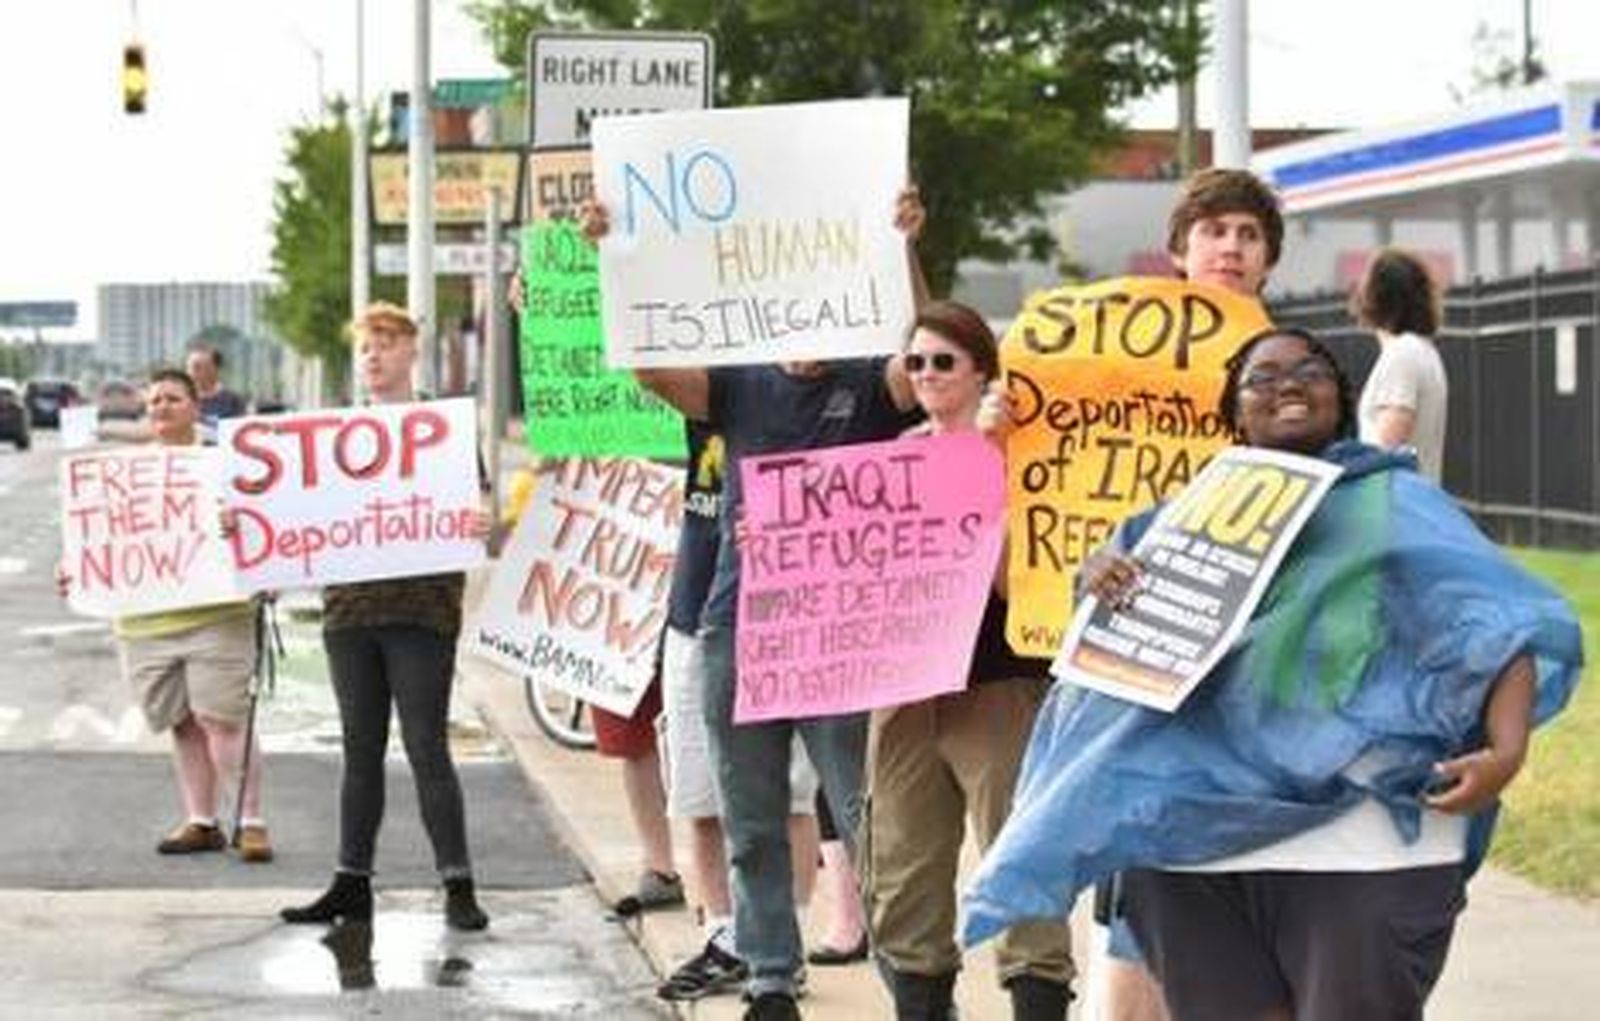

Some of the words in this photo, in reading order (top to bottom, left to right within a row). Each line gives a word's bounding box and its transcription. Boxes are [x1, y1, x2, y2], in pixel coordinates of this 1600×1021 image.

[542, 55, 619, 85] RIGHT
[631, 59, 700, 88] LANE
[622, 150, 737, 237] NO
[713, 217, 860, 287] HUMAN
[628, 299, 706, 352] IS
[1023, 293, 1224, 369] STOP
[68, 453, 200, 498] FREE
[231, 410, 449, 495] STOP
[1022, 434, 1076, 495] of
[1087, 437, 1214, 502] IRA
[69, 494, 200, 539] THEM
[757, 454, 926, 531] IRAQI
[1162, 463, 1311, 553] NO!
[80, 532, 206, 591] NOW!
[748, 512, 982, 580] REFUGEES
[1027, 504, 1116, 572] REF
